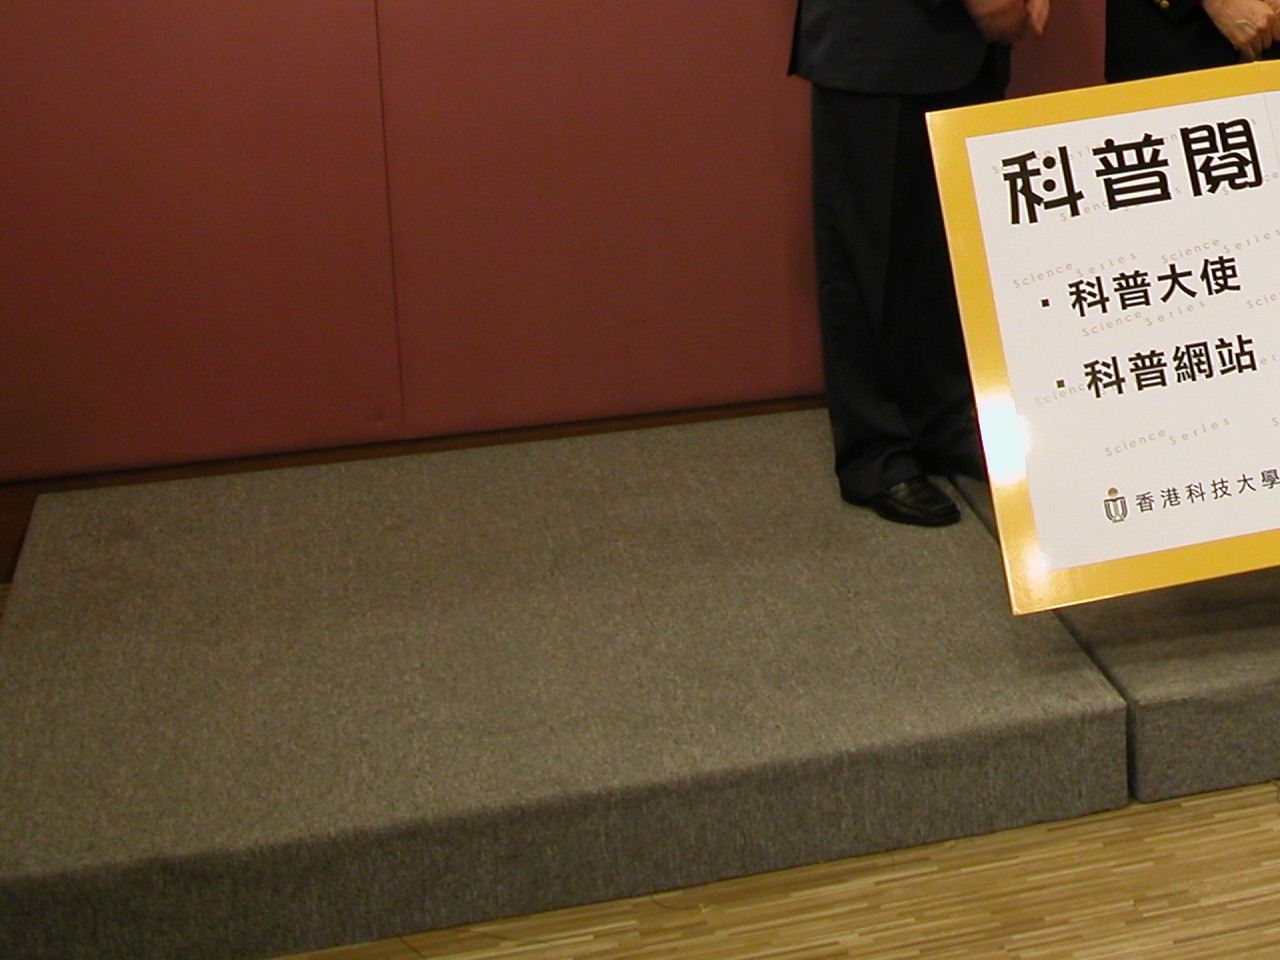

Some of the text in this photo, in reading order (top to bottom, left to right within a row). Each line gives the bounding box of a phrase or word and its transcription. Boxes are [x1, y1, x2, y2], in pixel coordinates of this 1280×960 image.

[1067, 255, 1242, 318] 科普大使
[1082, 333, 1259, 399] 科普網站
